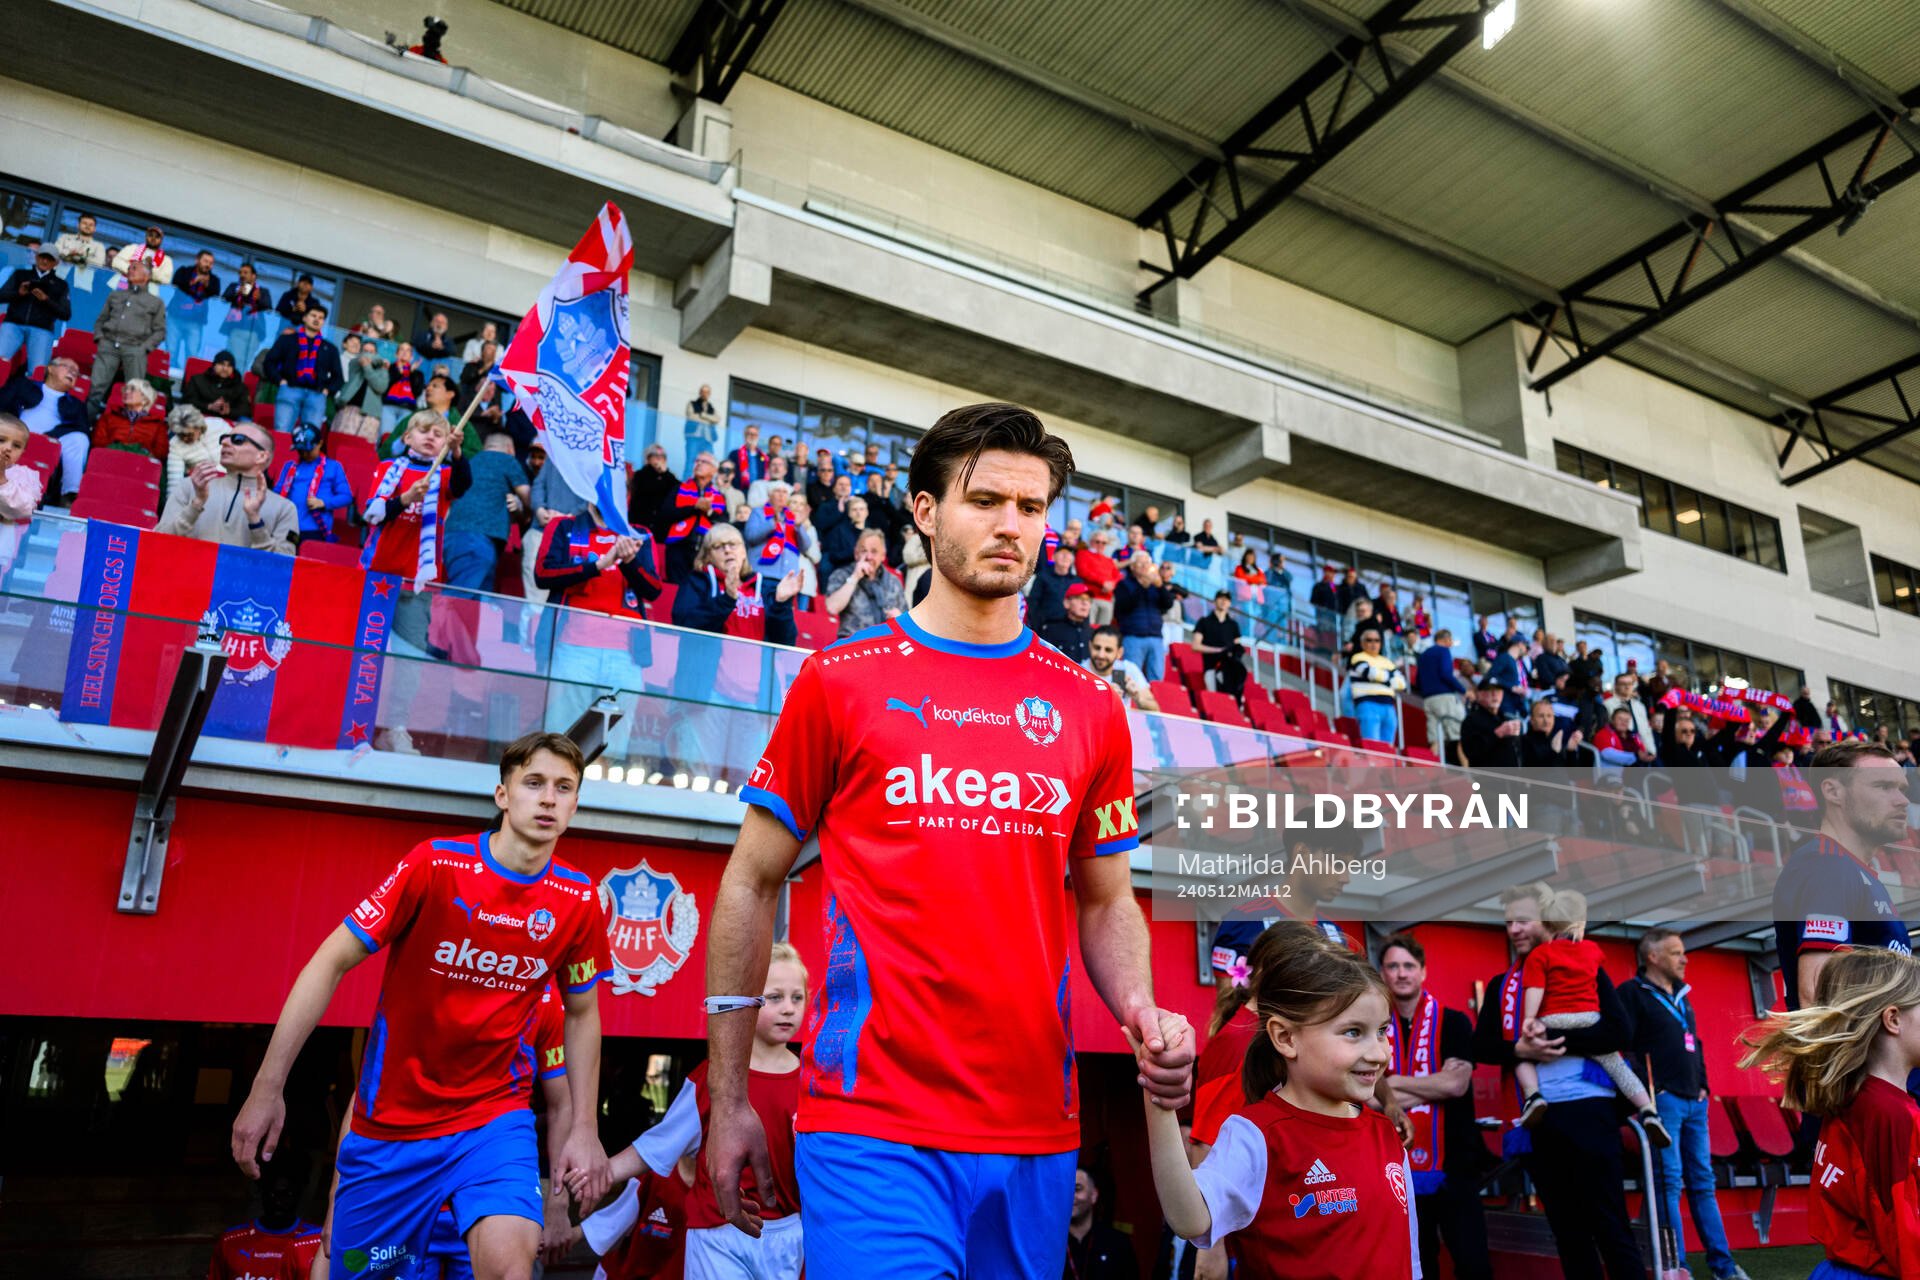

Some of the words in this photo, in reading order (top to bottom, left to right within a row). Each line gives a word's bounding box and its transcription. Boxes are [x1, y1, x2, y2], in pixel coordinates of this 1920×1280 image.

[107, 534, 128, 555] IF
[354, 611, 386, 705] OLYMPIA
[823, 647, 891, 666] SVALNER
[1029, 652, 1087, 680] SVALNER
[933, 705, 1011, 726] kondektor
[885, 754, 1021, 809] akea
[919, 816, 955, 829] PART
[960, 818, 979, 831] OF
[1004, 822, 1044, 836] ELEDA
[478, 909, 525, 928] kondektor
[434, 938, 519, 977] akea
[448, 972, 470, 981] PART
[498, 981, 526, 992] ELEDA
[1304, 1173, 1337, 1185] adidas
[1820, 1163, 1845, 1189] IF
[1316, 1187, 1356, 1204] INTER
[1318, 1199, 1358, 1215] SPORT
[370, 1244, 406, 1260] Solid
